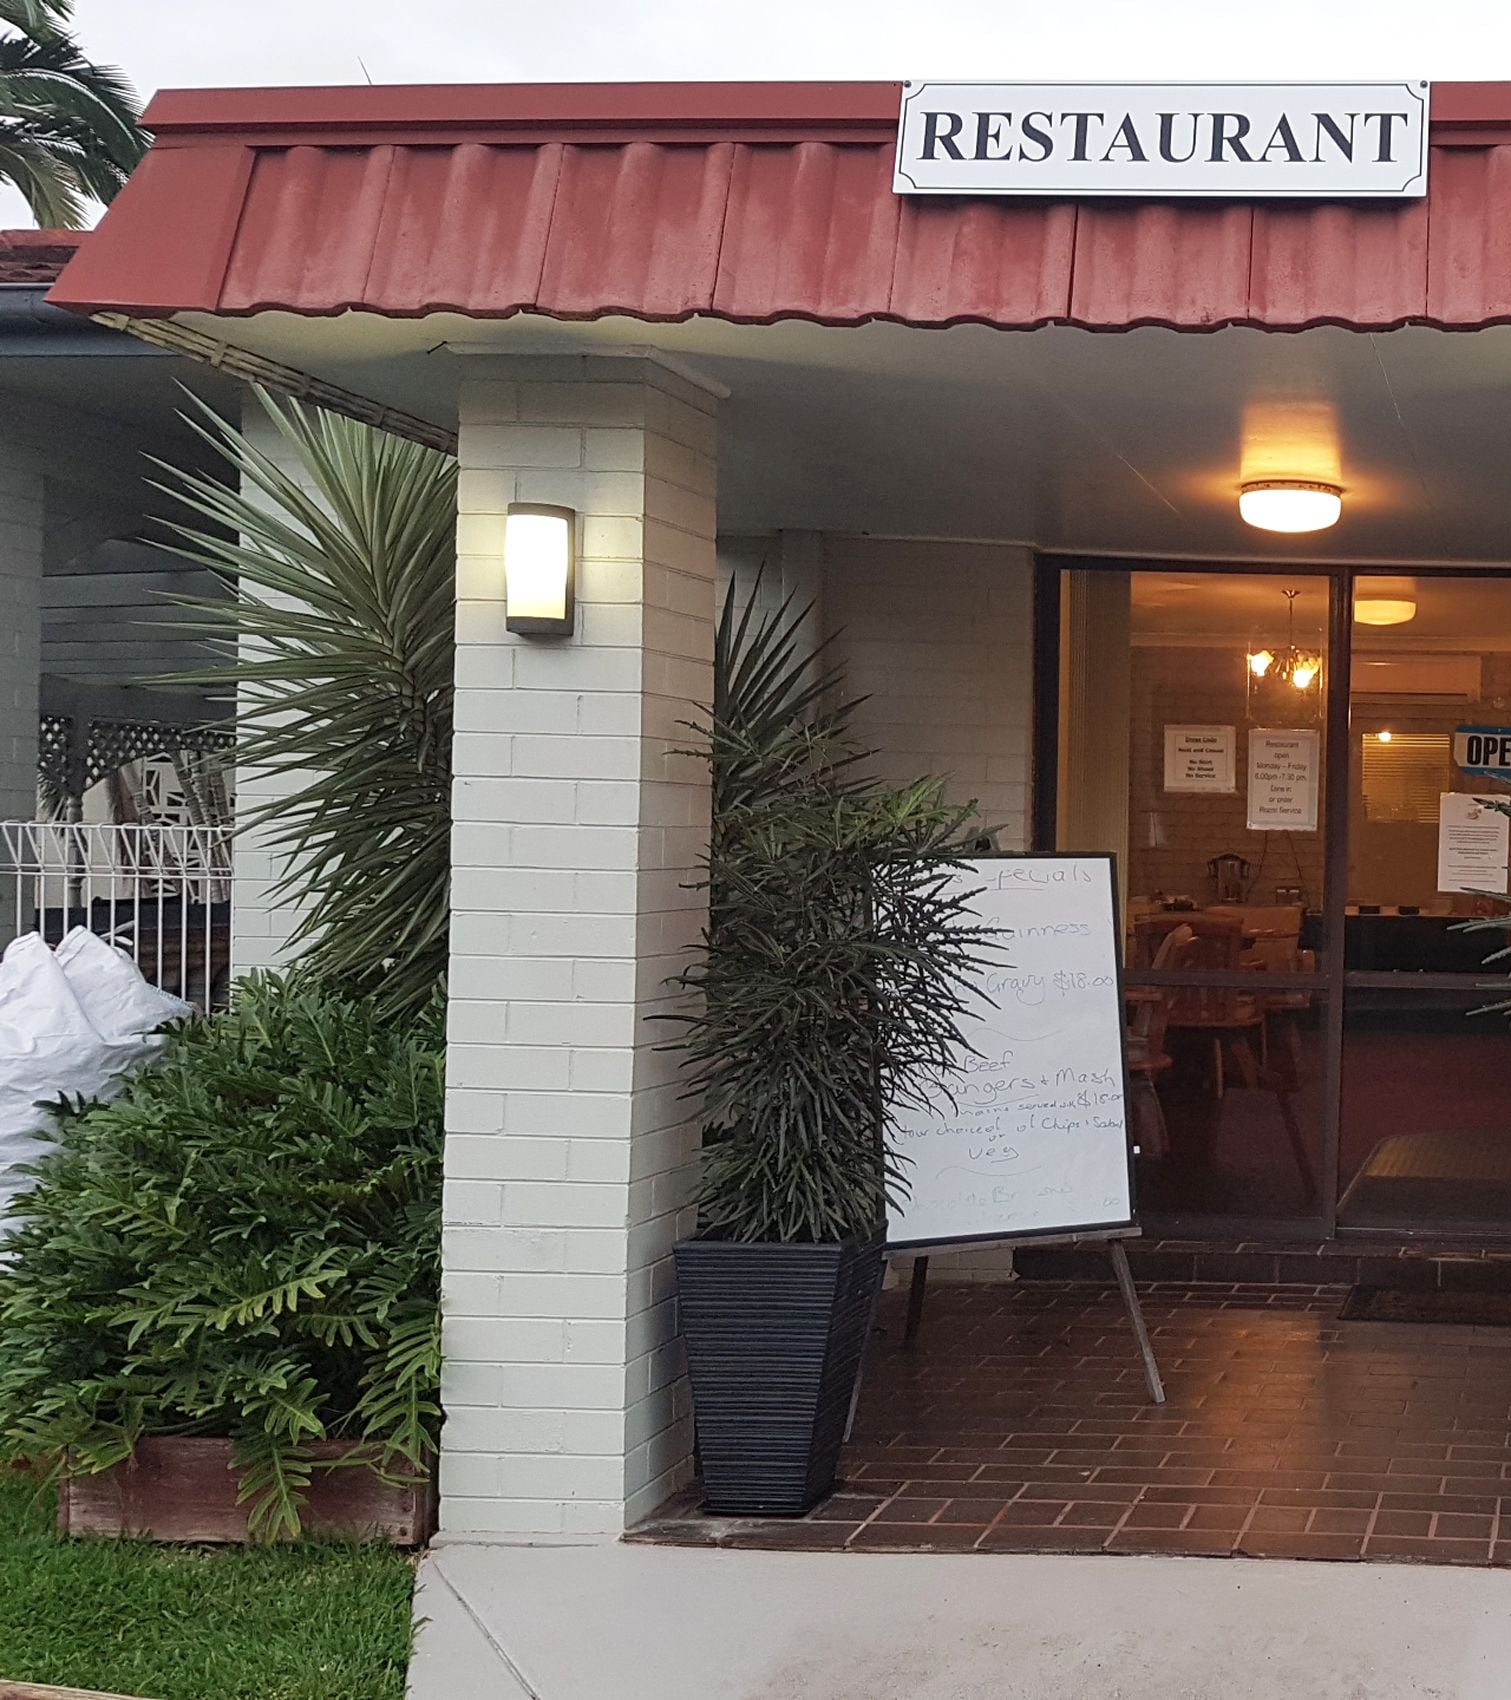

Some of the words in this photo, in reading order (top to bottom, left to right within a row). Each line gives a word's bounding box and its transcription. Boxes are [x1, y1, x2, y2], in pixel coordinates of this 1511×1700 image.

[915, 111, 1408, 163] RESTAURANT
[1265, 740, 1299, 748] Restaurant
[1274, 752, 1289, 760] open
[1256, 761, 1280, 770] Monday
[1288, 762, 1306, 771] Friday
[1279, 806, 1302, 814] Service
[963, 1050, 1014, 1073] Beef
[1056, 1067, 1116, 1087] Mash
[1041, 1116, 1080, 1135] Chips
